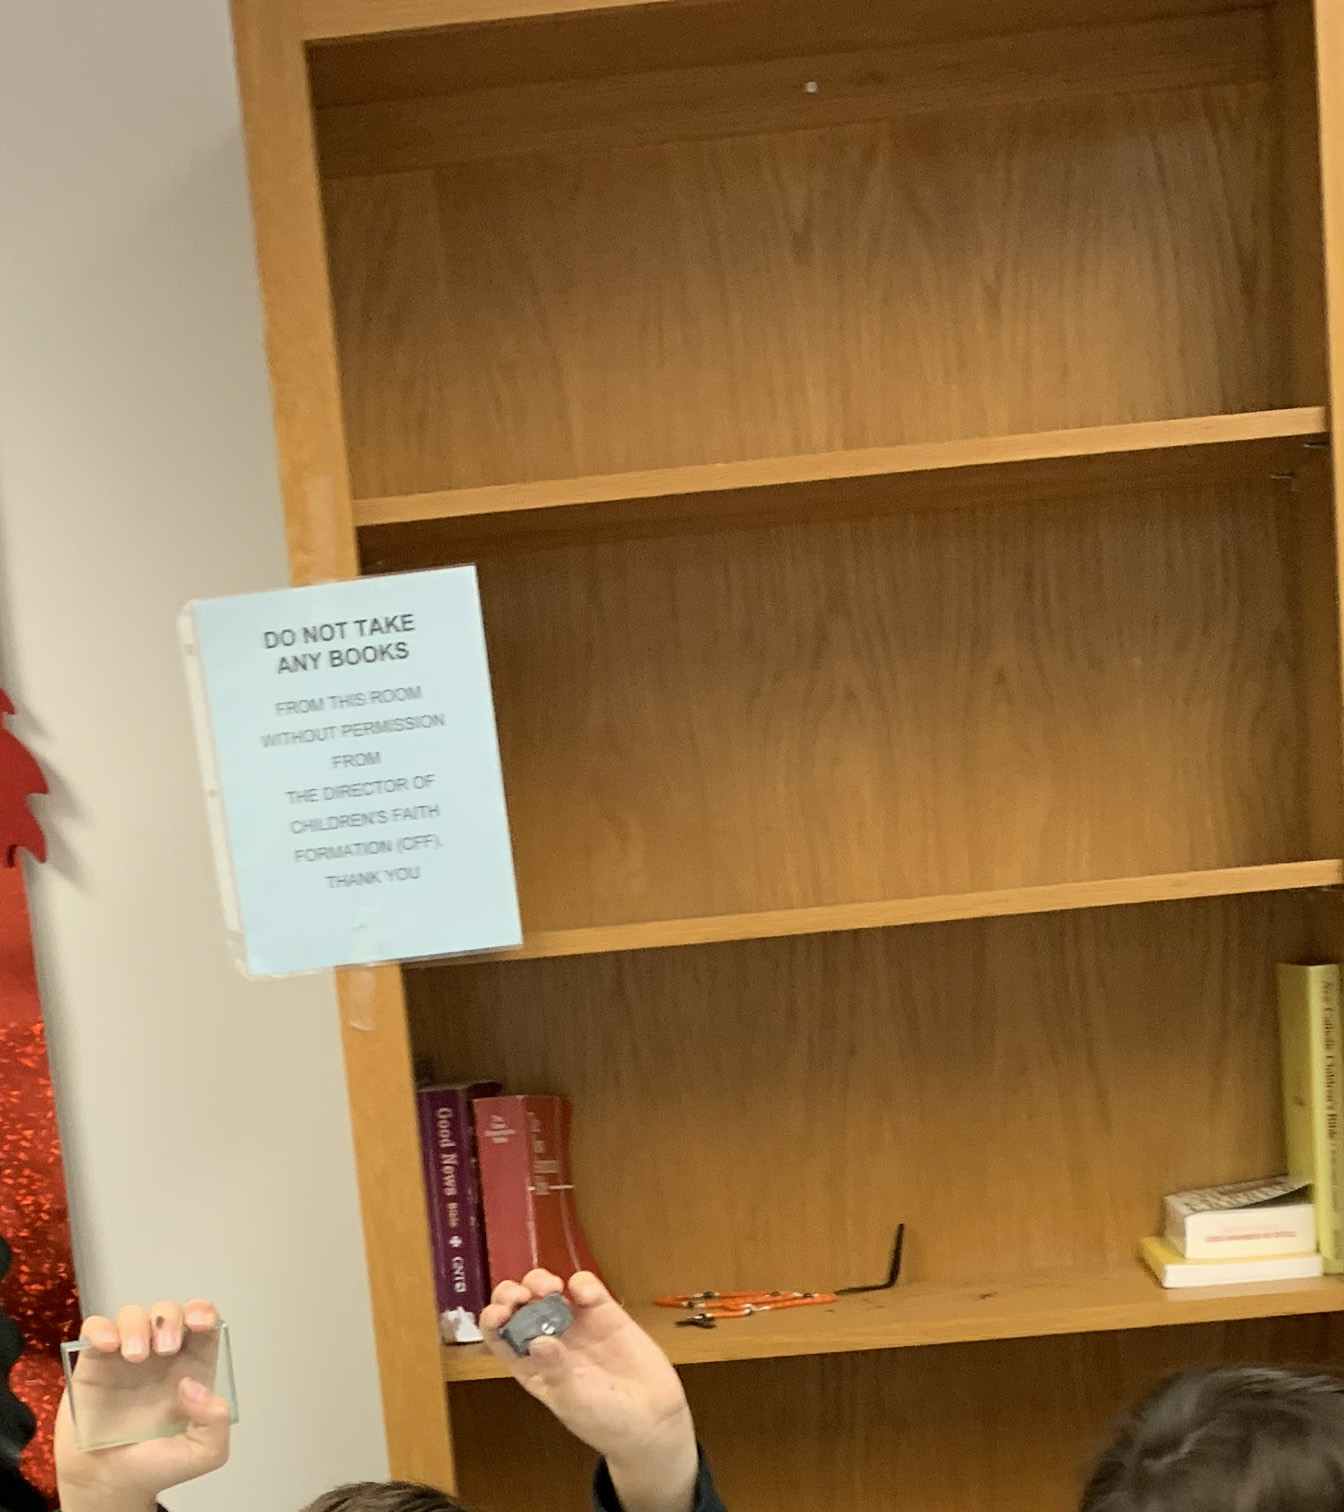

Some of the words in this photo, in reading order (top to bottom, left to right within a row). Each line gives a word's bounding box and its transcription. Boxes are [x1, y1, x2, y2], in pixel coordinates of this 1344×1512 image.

[263, 629, 296, 649] DO
[303, 621, 347, 644] NOT
[354, 613, 415, 637] TAKE
[277, 652, 321, 674] ANY
[328, 641, 410, 668] BOOKS
[274, 697, 325, 716] FROM
[328, 692, 366, 710] THIS
[370, 685, 424, 705] ROOM
[260, 725, 337, 748] WITHOUT
[340, 713, 446, 738] PERMISSION
[330, 751, 382, 768] FROM
[285, 788, 319, 804] THE
[322, 777, 409, 801] DIRECTOR
[412, 773, 435, 790] OF
[289, 810, 389, 835] CHILDREN'S
[391, 804, 441, 822] FAITH
[294, 840, 393, 863] FORMATION
[324, 870, 382, 889] THANK
[384, 865, 421, 883] YOU
